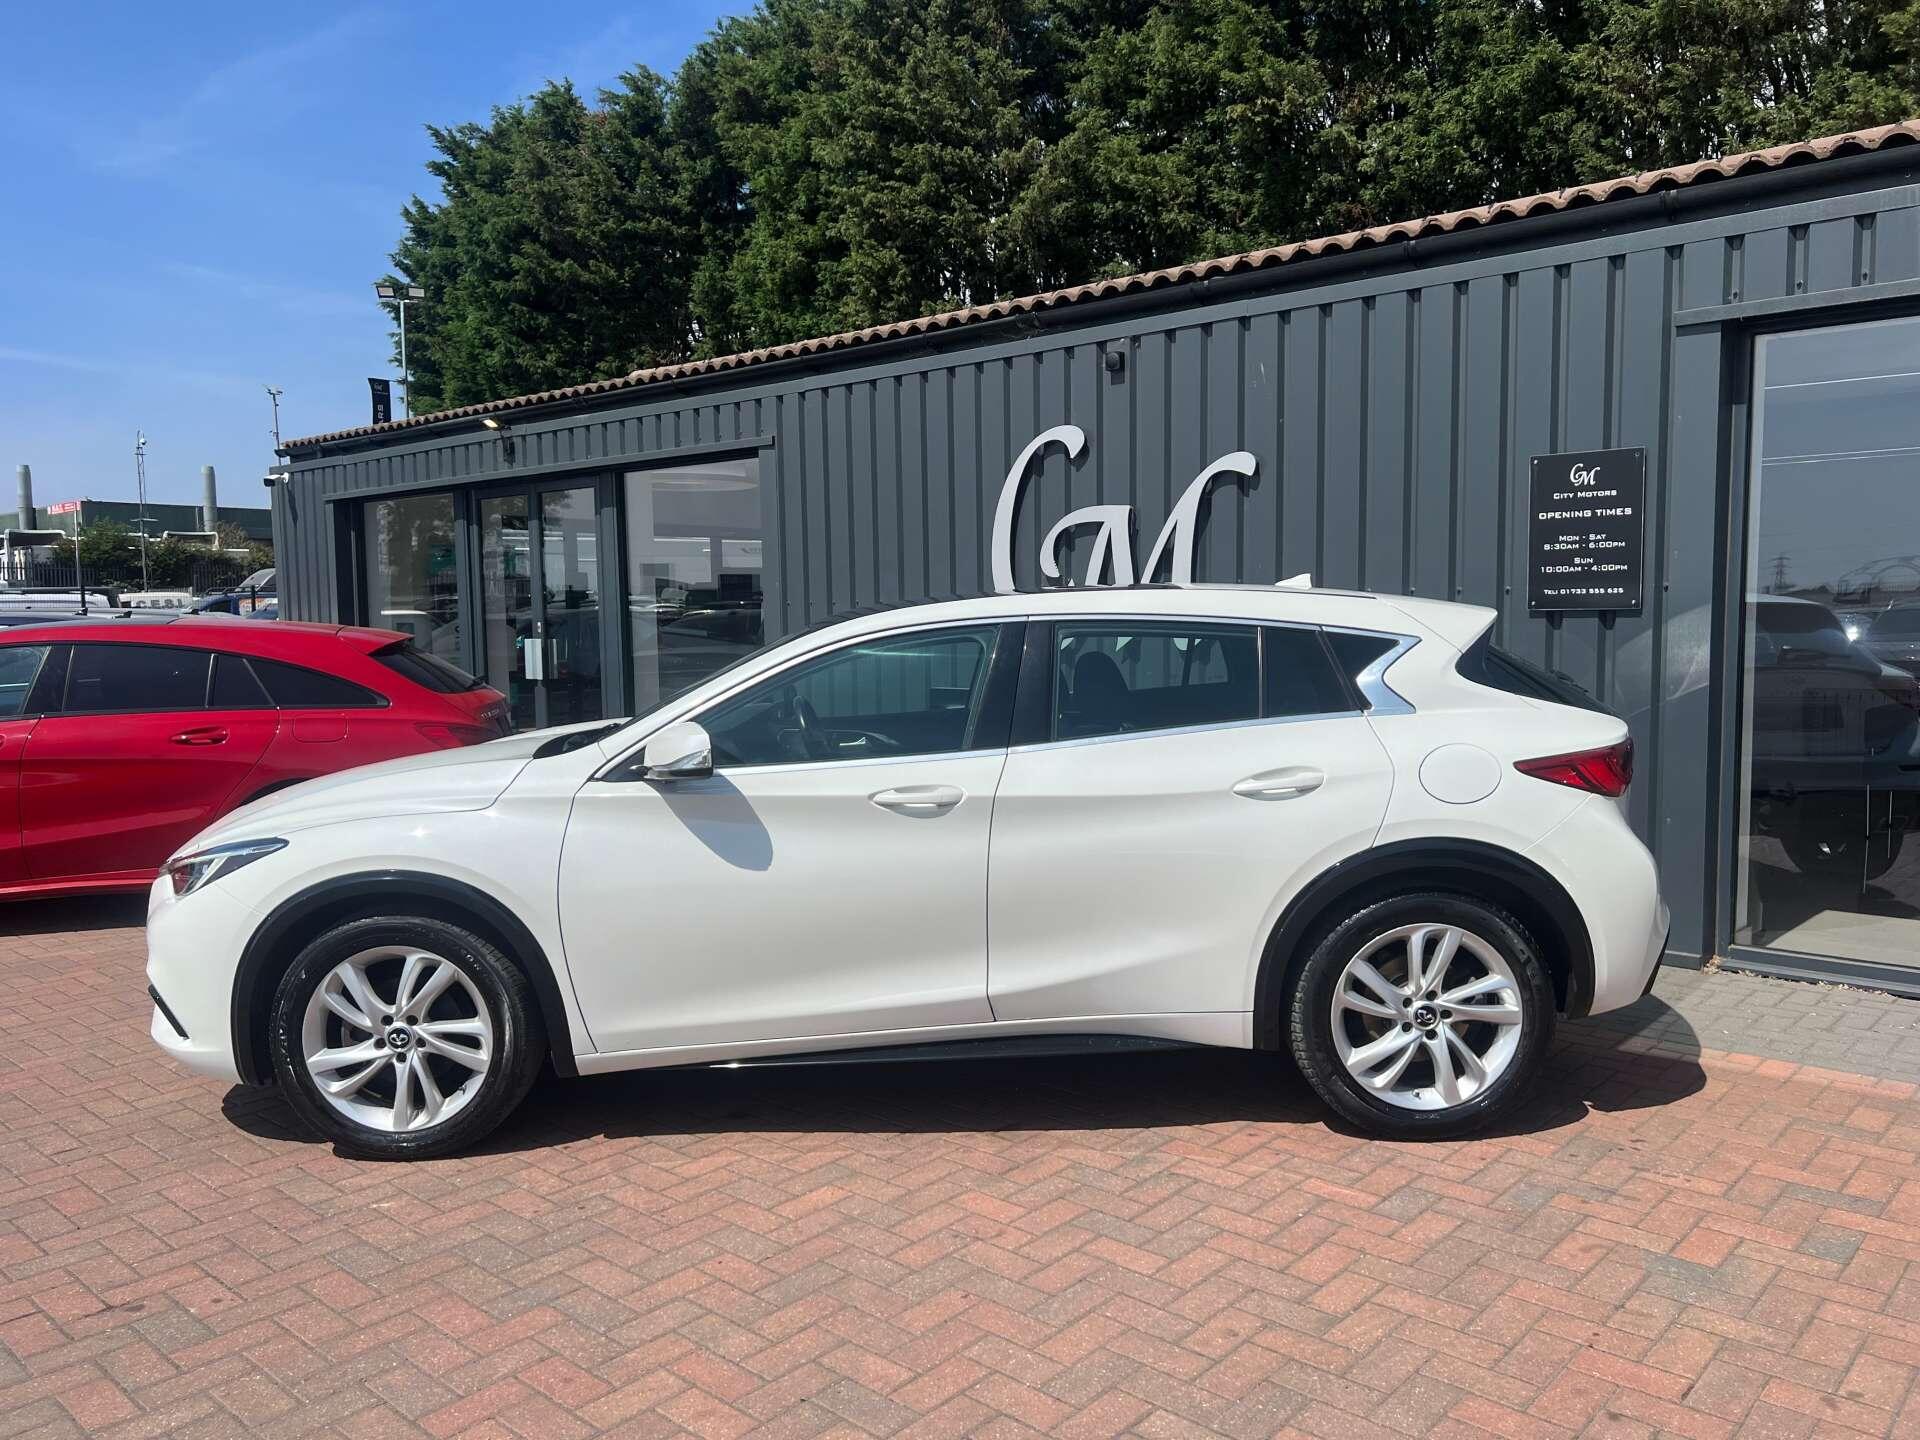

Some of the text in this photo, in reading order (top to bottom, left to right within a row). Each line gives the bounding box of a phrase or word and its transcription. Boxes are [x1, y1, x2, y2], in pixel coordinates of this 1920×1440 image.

[1578, 490, 1617, 498] MOTORS
[1539, 508, 1632, 519] OPENING TIMES
